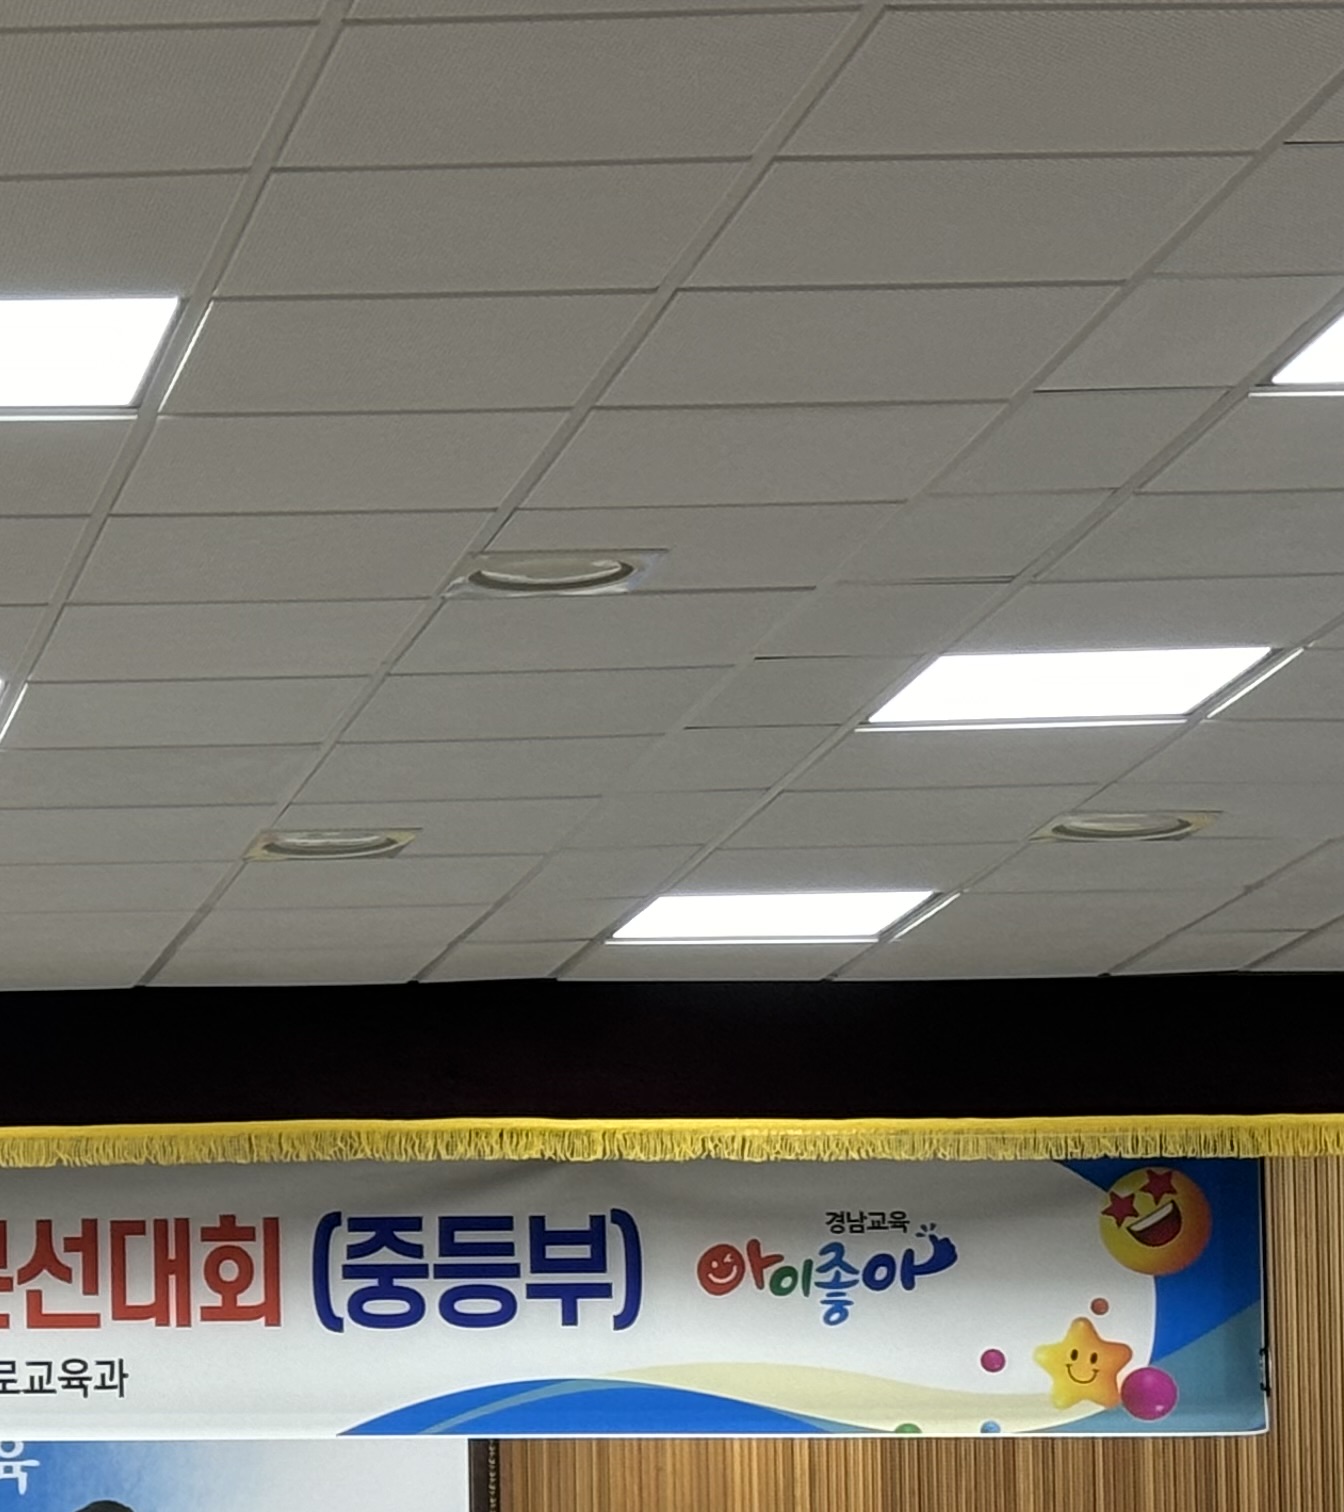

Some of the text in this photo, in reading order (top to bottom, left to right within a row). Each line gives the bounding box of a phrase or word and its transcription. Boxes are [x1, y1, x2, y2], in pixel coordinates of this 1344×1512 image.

[825, 1210, 910, 1234] 경남교육
[312, 1208, 642, 1333] (중등부)
[697, 1235, 958, 1329] 아이좋아
